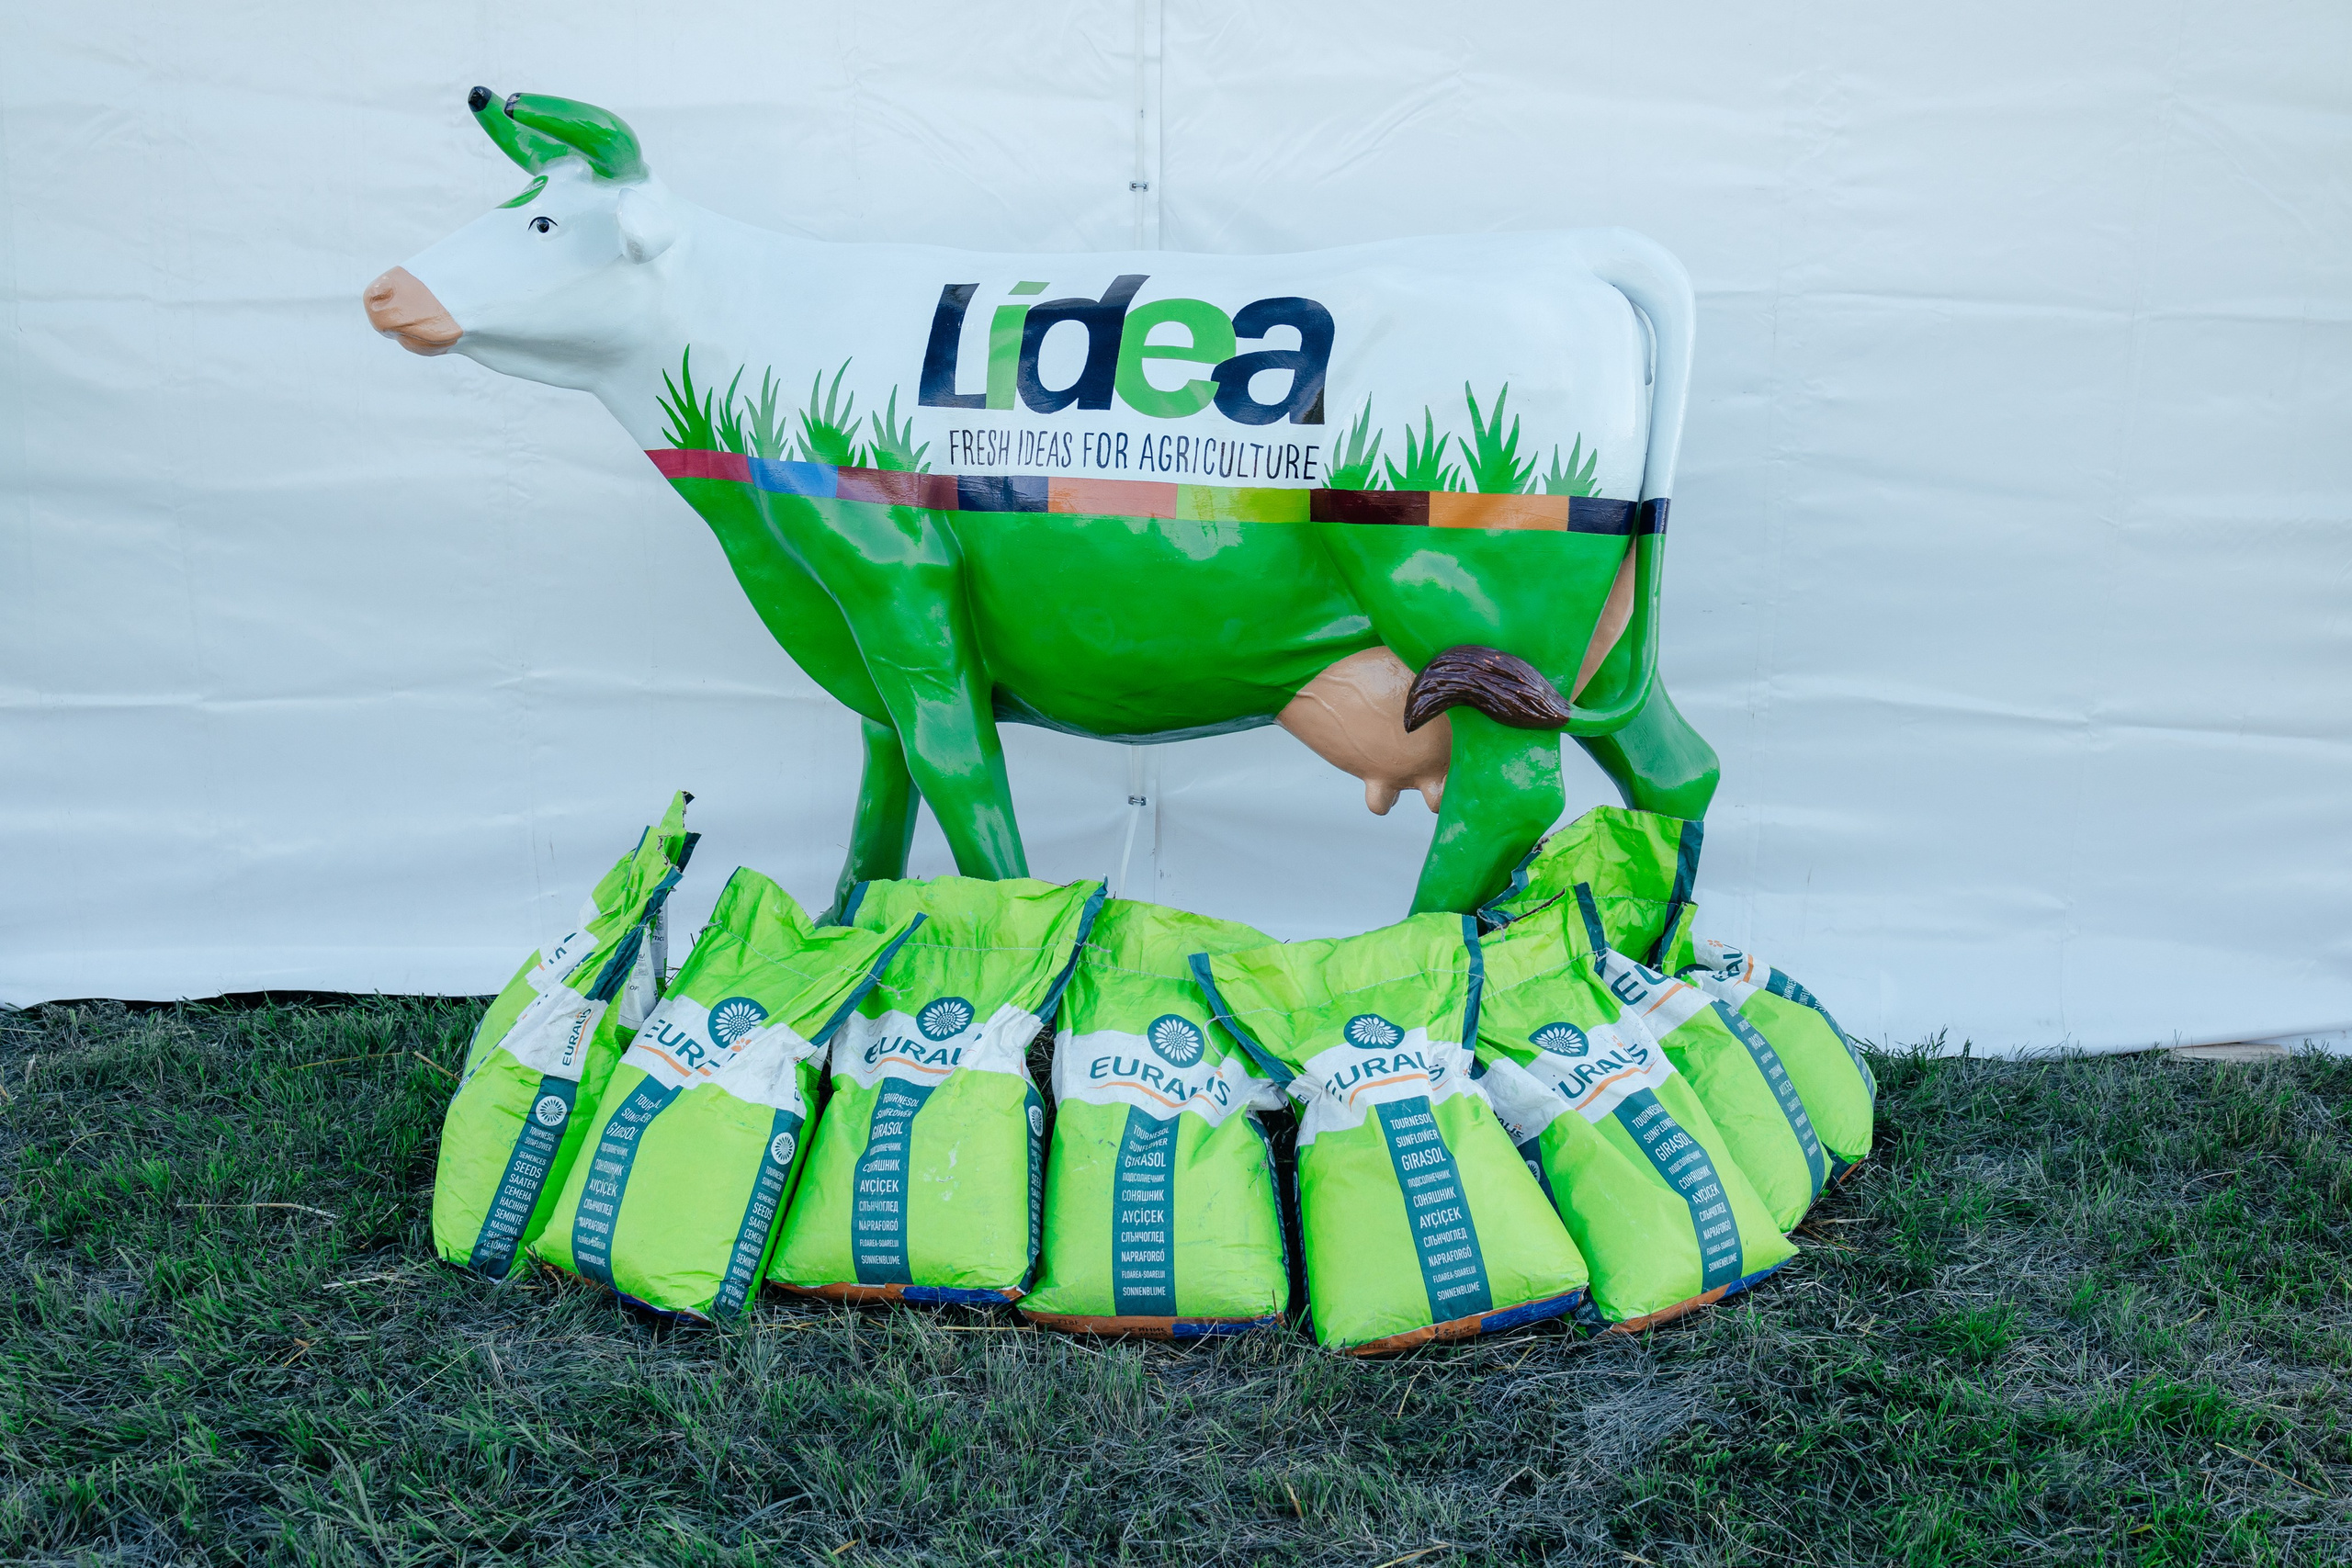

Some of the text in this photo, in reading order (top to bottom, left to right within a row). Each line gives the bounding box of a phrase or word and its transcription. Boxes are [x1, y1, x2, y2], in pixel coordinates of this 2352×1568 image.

[918, 274, 1336, 425] Lidea
[949, 429, 1320, 480] FRESH IDEAS FOR AGRICULTURE
[882, 1093, 920, 1108] TOURNESOL
[1389, 1112, 1433, 1130] TOURNESOL
[871, 1122, 903, 1140] GIRASOL
[1133, 1124, 1170, 1141] TOURNESOL
[1396, 1130, 1439, 1147] SUNFLOWER
[1128, 1138, 1168, 1152] SUNFLOWER
[1655, 1132, 1693, 1161] GIRASOL
[518, 1150, 547, 1166] SEMENCES
[1125, 1152, 1166, 1168] GIRASOL
[1401, 1146, 1446, 1171] GIRASOL
[514, 1160, 543, 1179] SEEDS
[1122, 1172, 1165, 1183] ПОДСОЛНЕЧНИК
[509, 1173, 538, 1190] SAATEN
[859, 1178, 899, 1195] AYÇİÇEK
[1408, 1169, 1451, 1188] ПОДСОЛНЕЧНИК
[1122, 1190, 1164, 1201] СОНЯШНИК
[1413, 1186, 1456, 1208] СОНЯШНИК
[1691, 1182, 1720, 1204] AYÇİÇEK
[752, 1201, 774, 1221] SEEDS
[859, 1201, 899, 1213] СЛЪНЧОГЛЕД
[748, 1215, 768, 1233] SAATEN
[859, 1218, 899, 1231] NAPRAFORGÓ
[1122, 1208, 1164, 1226] AYÇİÇEK
[1419, 1206, 1463, 1229] AYÇİÇEK
[490, 1220, 518, 1236] NASIONA
[1121, 1231, 1165, 1244] СЛЪНЧОГЛЕД
[1423, 1227, 1468, 1247] СЛЪНЧОГЛЕД
[861, 1255, 900, 1265] SONNENBLUME
[1121, 1248, 1165, 1262] NAPRAFORGÓ
[1428, 1244, 1472, 1267] NAPRAFORGÓ
[1121, 1269, 1166, 1279] FLOAREA-SOARELUI
[1433, 1265, 1476, 1283] FLOAREA-SOARELUI
[1122, 1286, 1166, 1296] SONNENBLUME
[1437, 1281, 1480, 1301] SONNENBLUME
